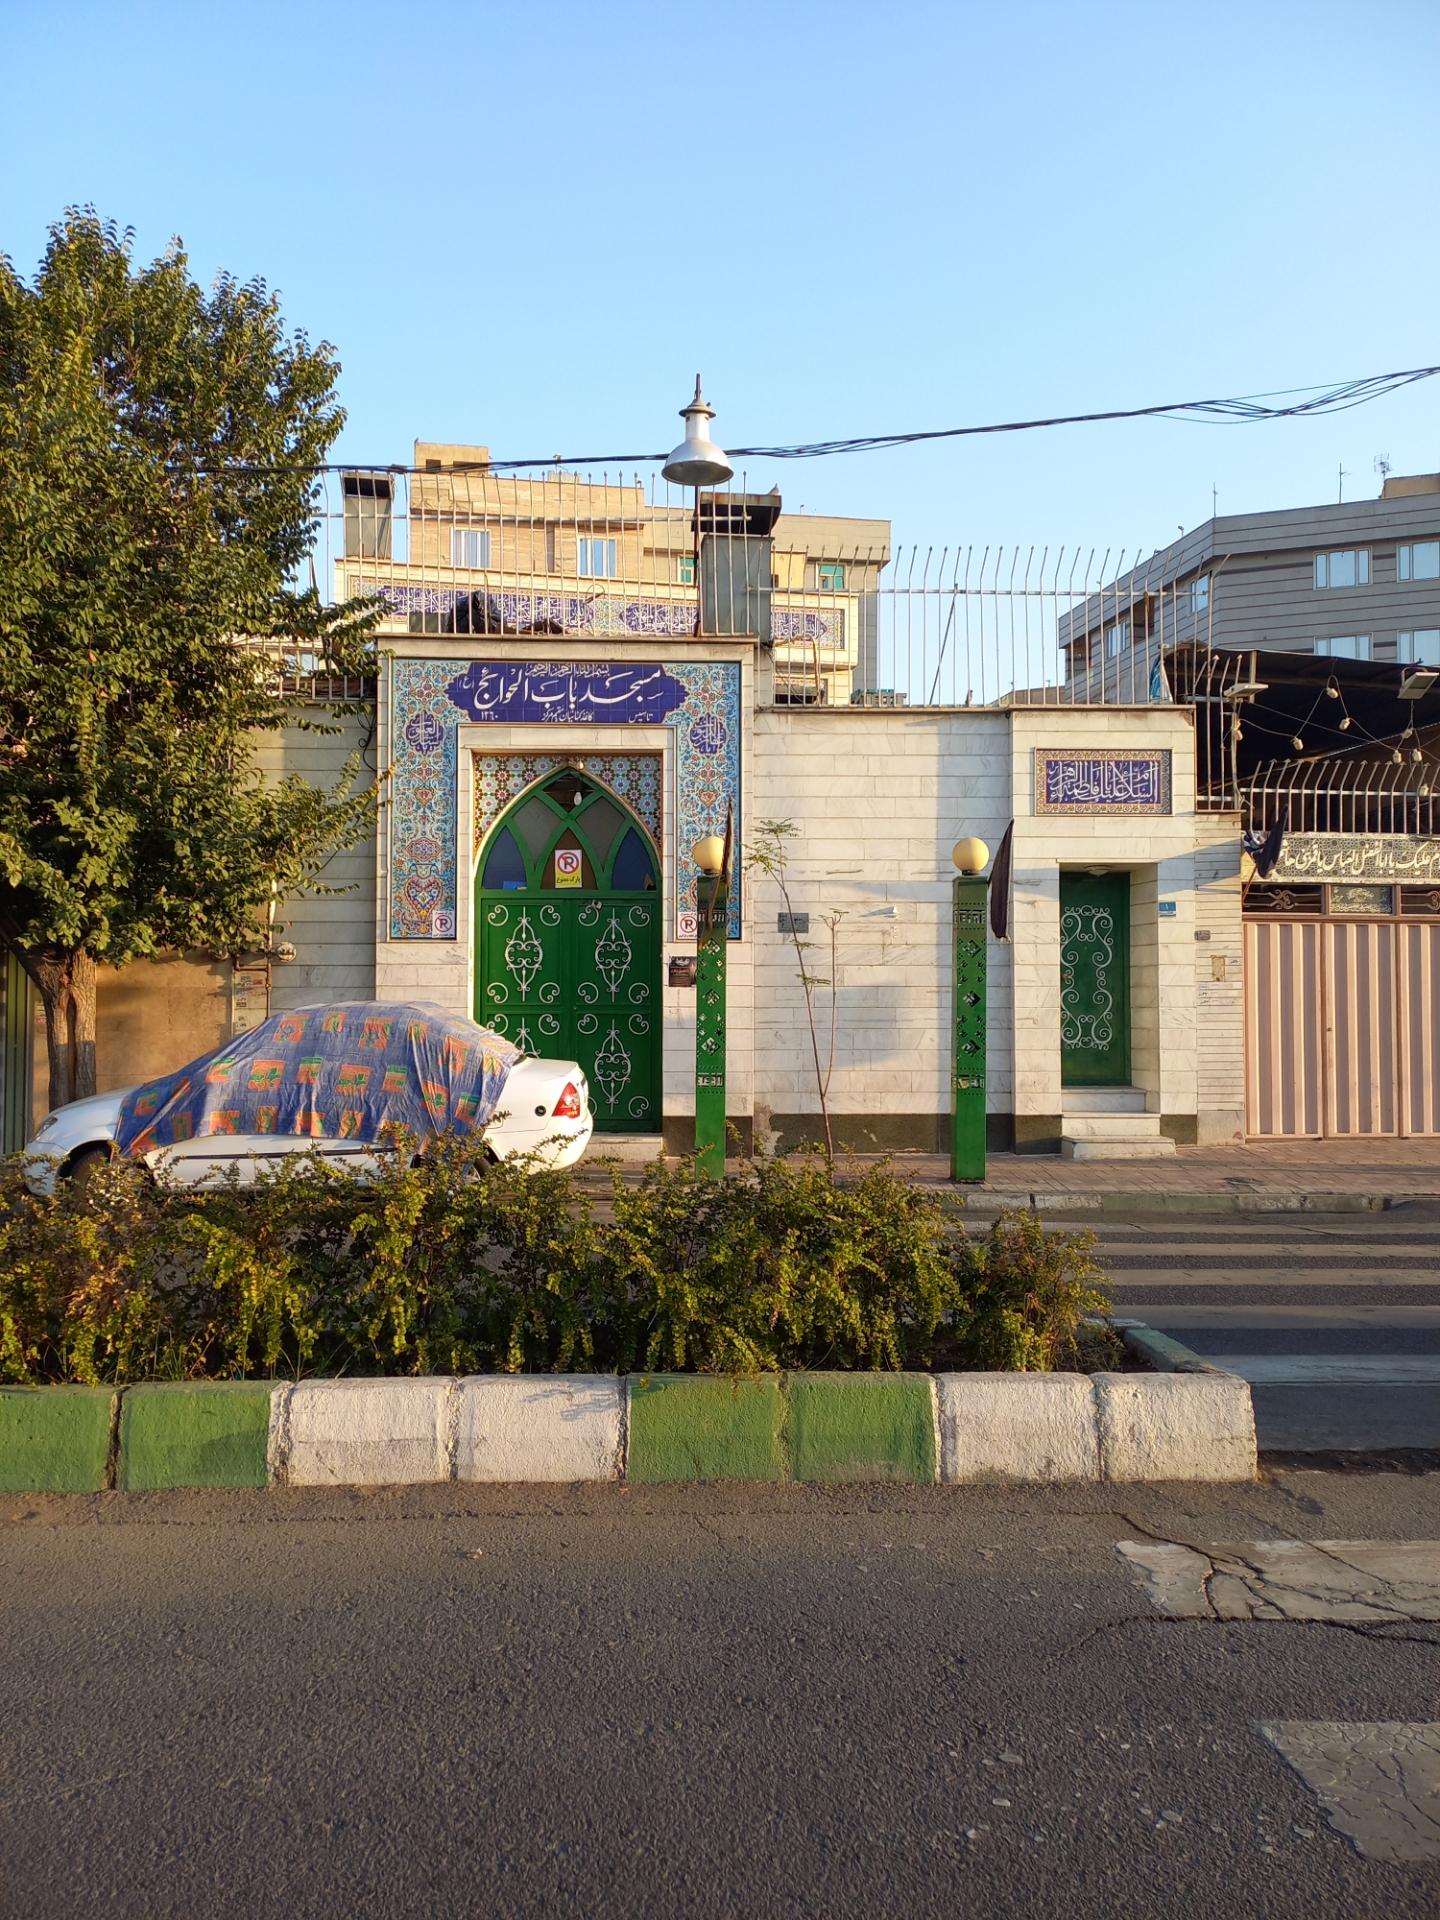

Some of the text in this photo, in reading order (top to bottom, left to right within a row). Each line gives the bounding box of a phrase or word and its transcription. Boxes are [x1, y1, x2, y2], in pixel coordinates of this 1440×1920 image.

[531, 674, 577, 709] باب
[579, 668, 664, 704] مسجد
[1323, 849, 1358, 875] العباس
[1388, 852, 1395, 875] یا
[1396, 841, 1430, 876] علیک
